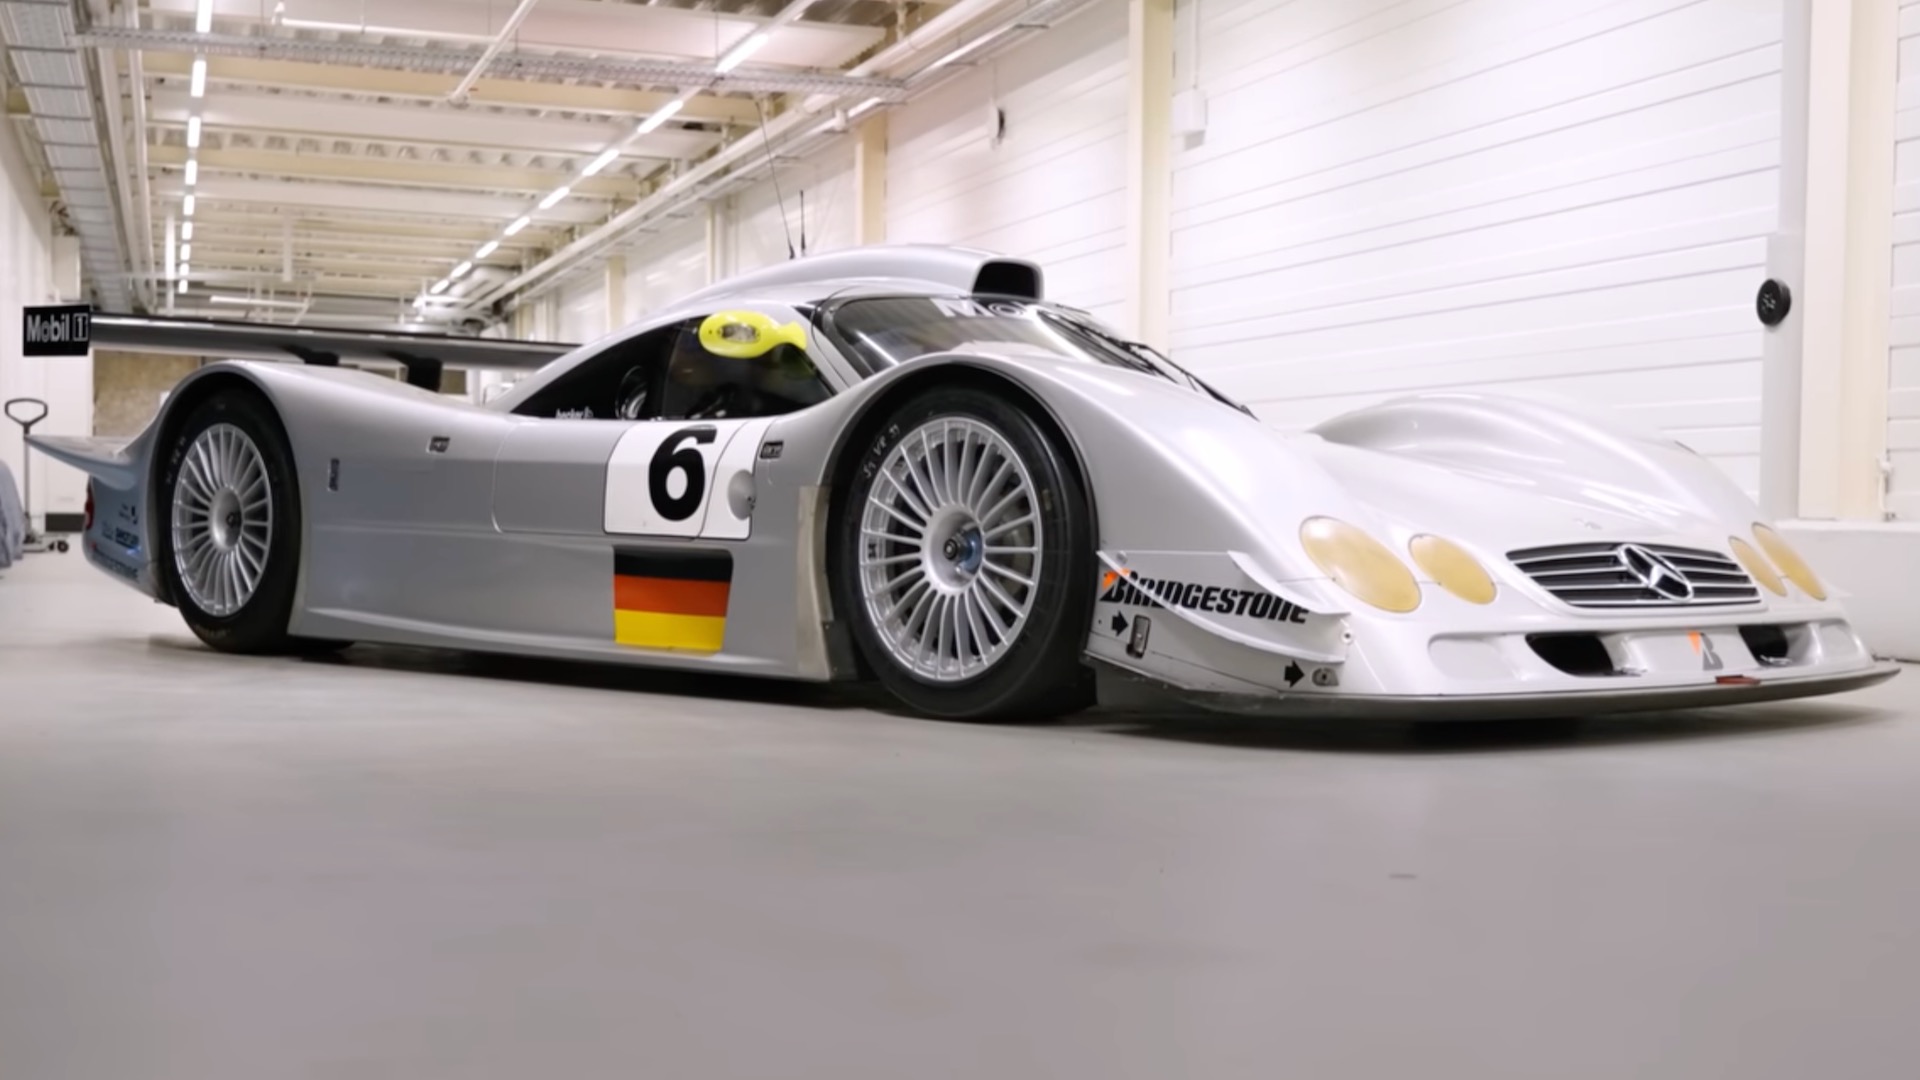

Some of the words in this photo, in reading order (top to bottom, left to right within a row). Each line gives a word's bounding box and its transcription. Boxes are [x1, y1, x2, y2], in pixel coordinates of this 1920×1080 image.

[27, 313, 70, 343] Mobil
[648, 424, 717, 521] 6
[1100, 570, 1309, 625] BRIDGESTONE
